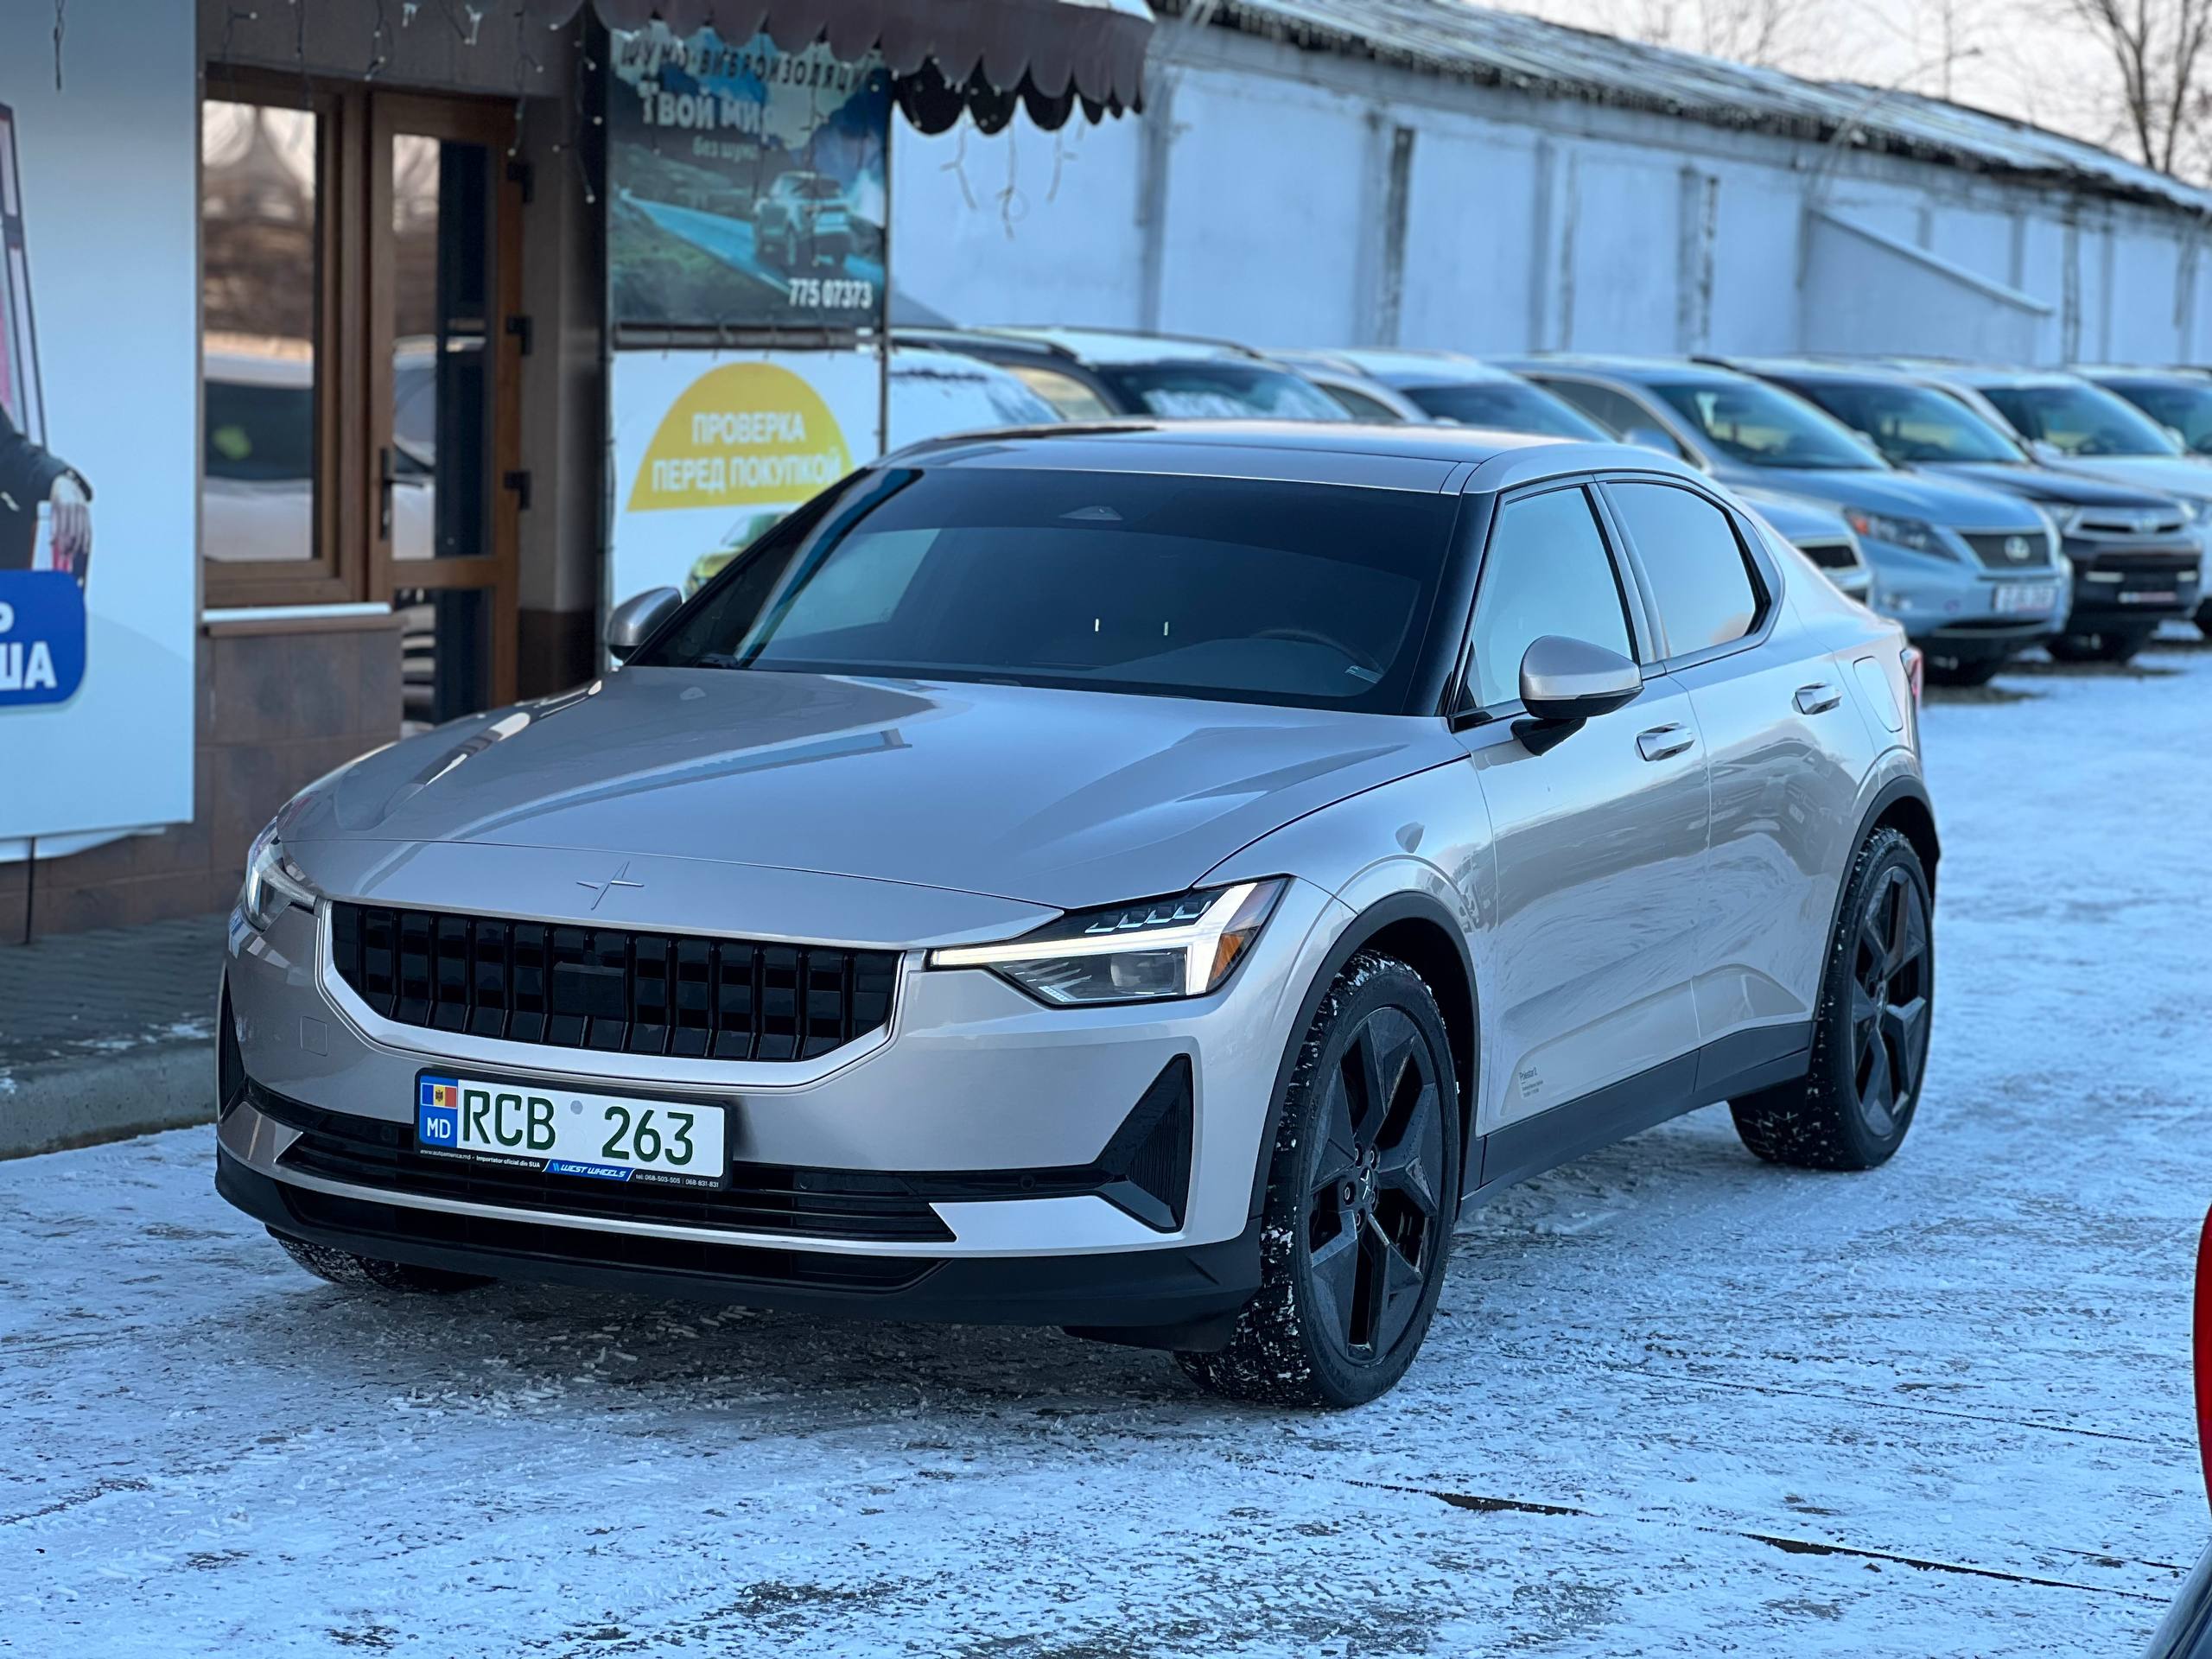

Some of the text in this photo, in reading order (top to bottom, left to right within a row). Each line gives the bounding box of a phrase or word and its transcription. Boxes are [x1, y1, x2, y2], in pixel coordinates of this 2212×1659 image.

[638, 82, 715, 130] ТВОЙ
[788, 277, 873, 309] 775 07373
[691, 411, 805, 444] ПРОВЕРКА
[652, 447, 842, 495] ПЕРЕД ПОКУПКОЙ
[426, 1117, 451, 1139] MD
[462, 1089, 695, 1166] RCB 263
[476, 1155, 503, 1165] Importator
[504, 1158, 518, 1166] oficial
[560, 1164, 626, 1177] WEST WHEELS
